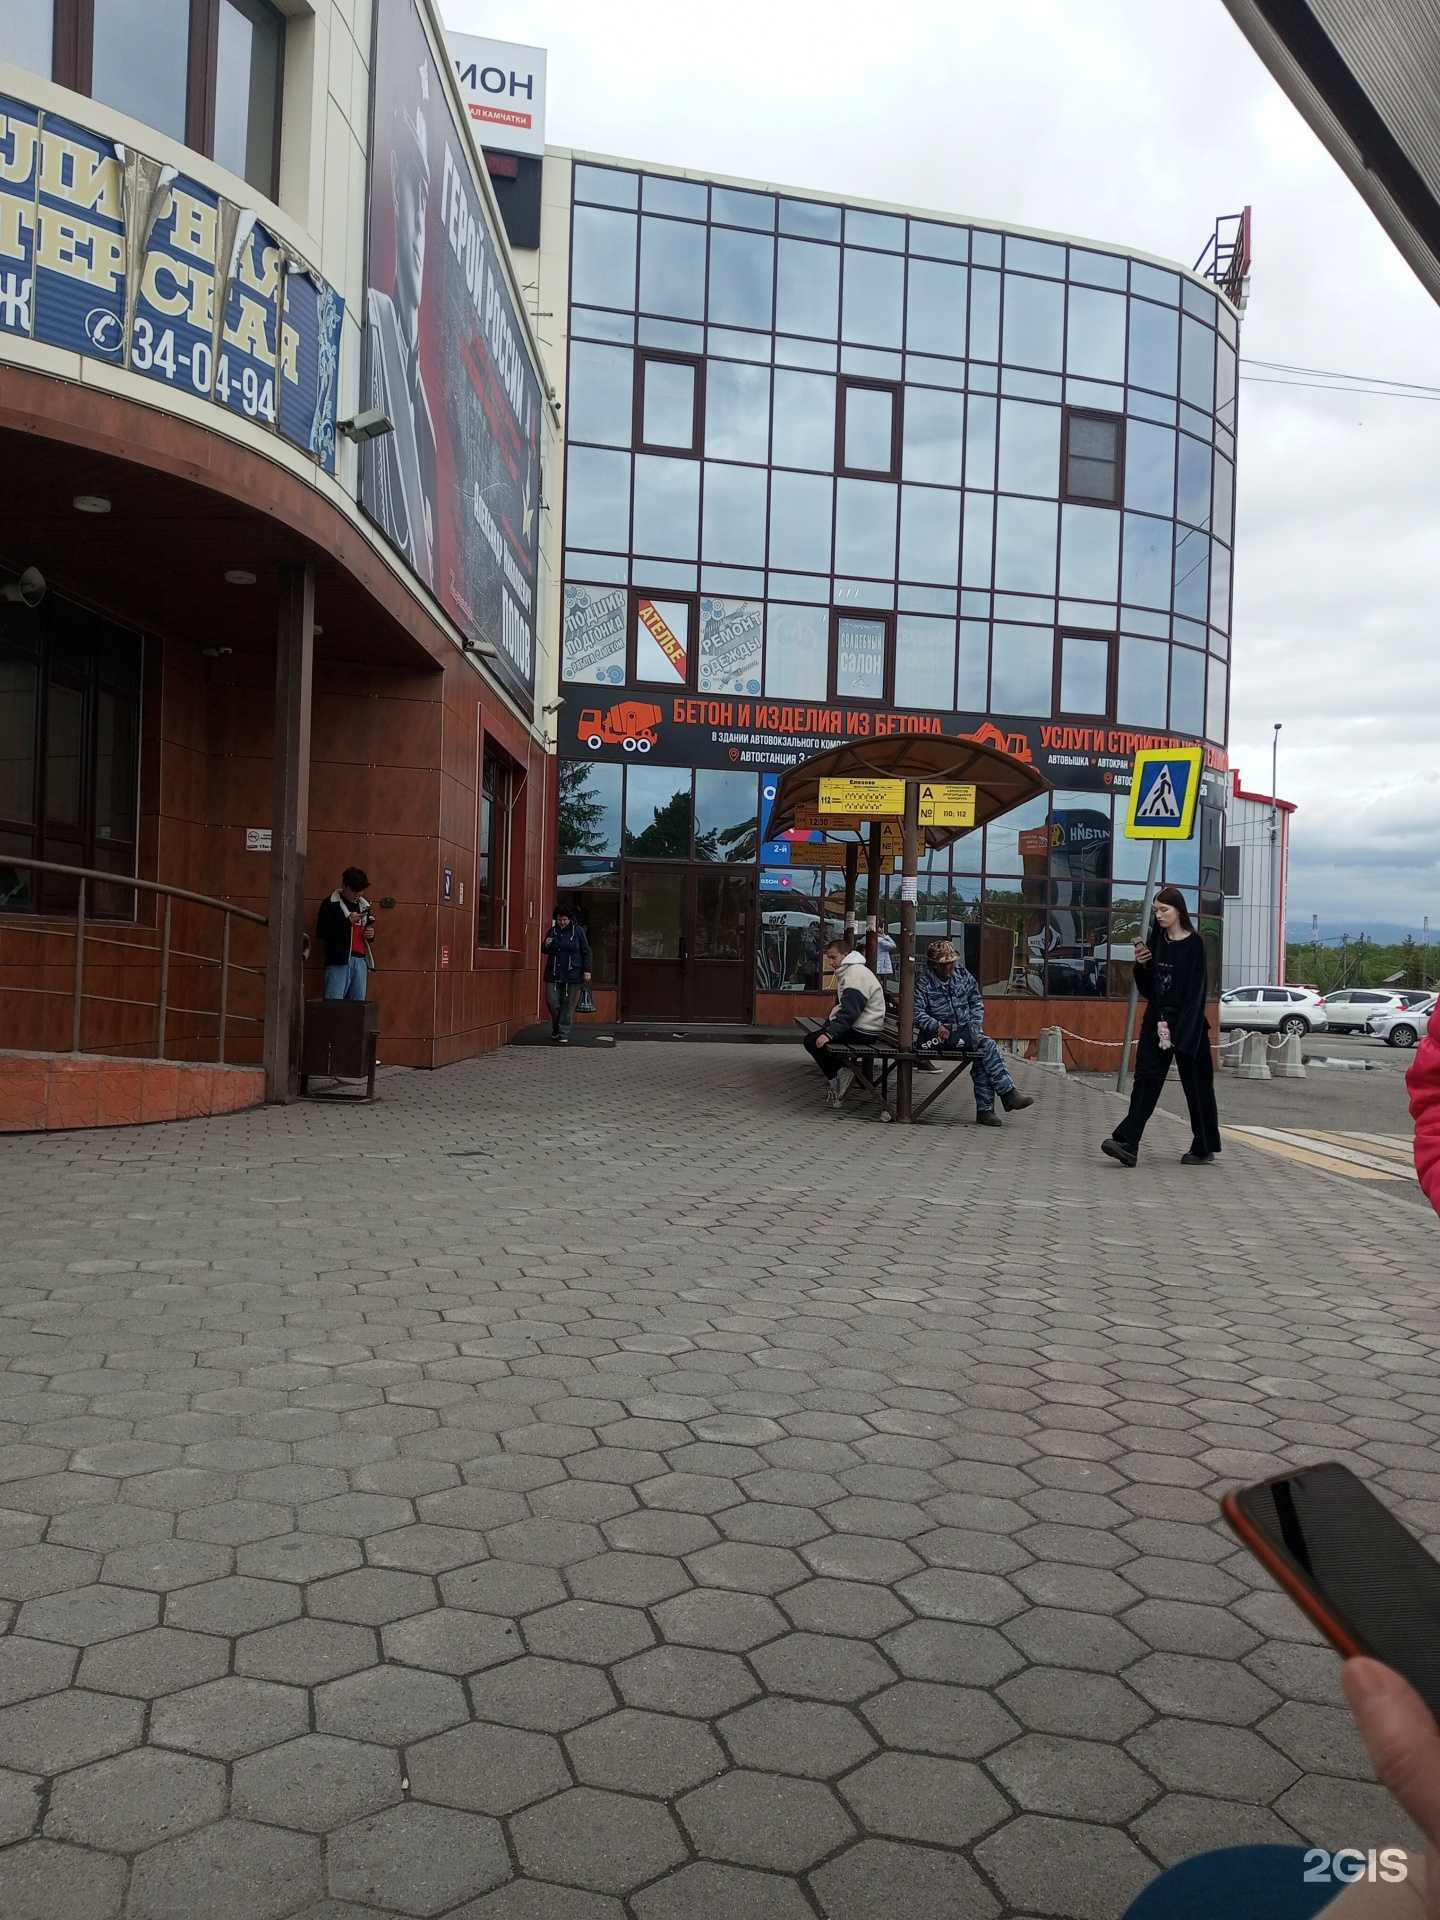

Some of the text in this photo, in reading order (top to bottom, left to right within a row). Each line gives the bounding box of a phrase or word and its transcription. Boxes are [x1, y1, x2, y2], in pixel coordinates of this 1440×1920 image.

[482, 109, 527, 124] КАМЧАТКИ
[441, 140, 525, 425] ГЕРОЙ РОССИИ
[131, 318, 277, 424] 34-04-94
[565, 590, 625, 633] ПОДШИВ
[502, 584, 531, 681] ПОПОВ
[565, 615, 624, 655] ПОДГОНКА
[638, 605, 686, 662] АТЕЛЬЕ
[702, 610, 762, 654] РЕМОНТ
[841, 631, 882, 650] СВАДЕБНЫЙ
[699, 637, 761, 678] ОДЕЖДЫ
[673, 699, 733, 727] БЕТОН
[737, 704, 751, 728] И
[755, 705, 842, 733] ИЗДЕЛИЯ
[847, 711, 870, 736] ИЗ
[711, 731, 851, 749] В ЗДАНИИ АВТОВОКЗАЛЬНОГО КОМП
[1040, 725, 1105, 752] УСЛУГИ
[740, 751, 796, 765] АВТОСТАНЦИЯ
[1048, 754, 1129, 769] АВТОВЫШКА АВТОКРАН
[922, 786, 934, 800] А
[920, 808, 933, 818] №
